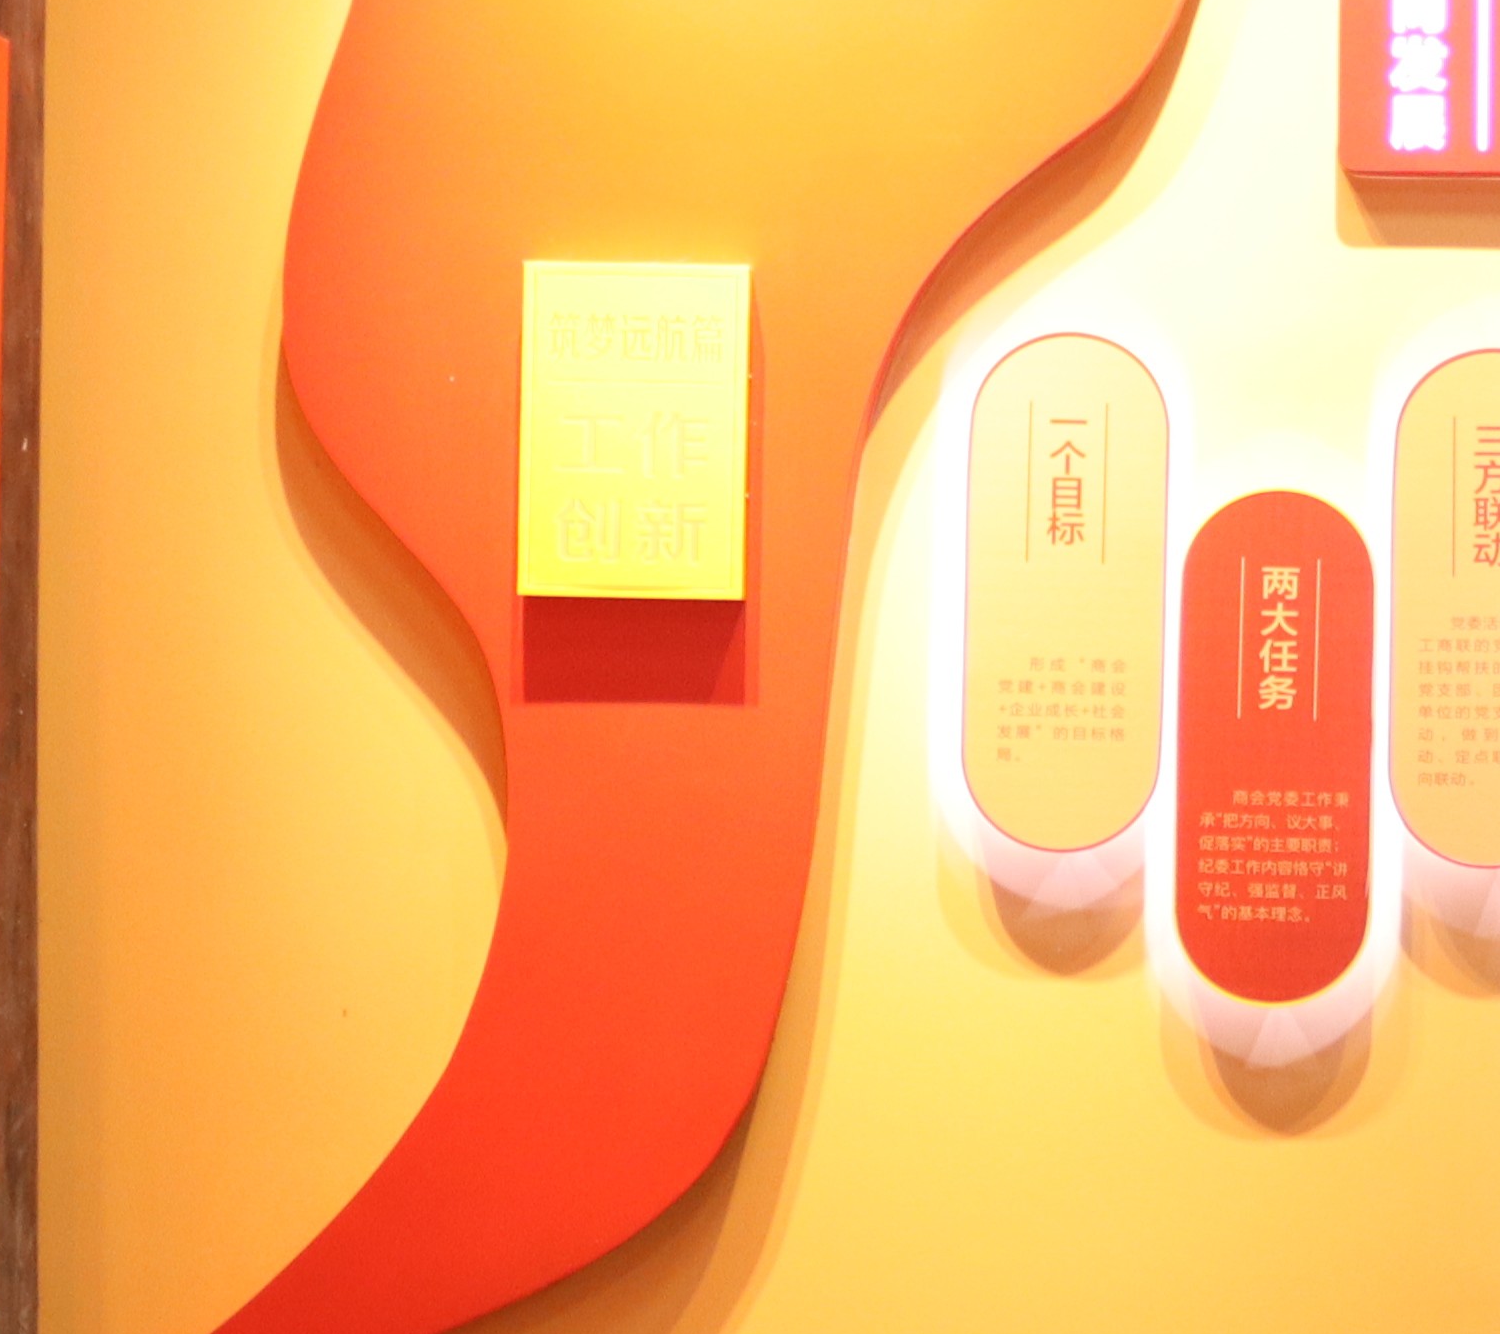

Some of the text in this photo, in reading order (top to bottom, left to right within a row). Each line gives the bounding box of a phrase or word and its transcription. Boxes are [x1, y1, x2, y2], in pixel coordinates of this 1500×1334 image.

[548, 311, 724, 364] 筑梦远航篇
[555, 410, 712, 480] 工作
[1047, 417, 1088, 546] 一个目标
[553, 497, 708, 566] 创新
[1258, 567, 1301, 712] 两大任务
[997, 679, 1127, 697] 党建+商会建设
[998, 702, 1126, 720] +企业成长+社会
[1232, 789, 1350, 808] 商会党委工作秉
[1197, 881, 1348, 900] 守纪、强监督、正风
